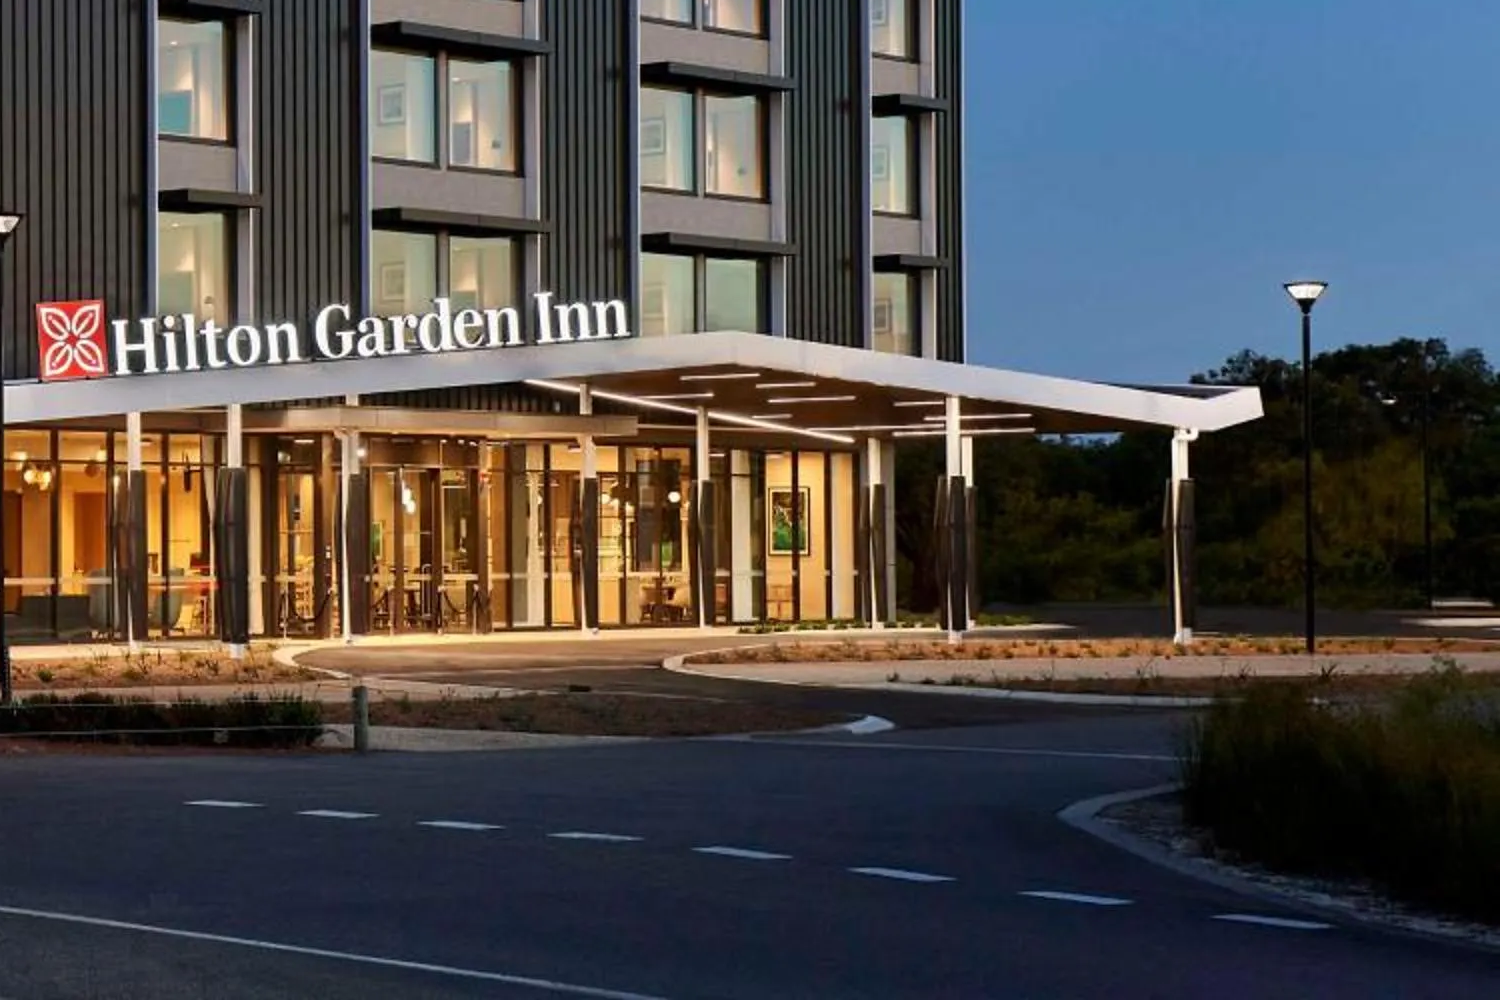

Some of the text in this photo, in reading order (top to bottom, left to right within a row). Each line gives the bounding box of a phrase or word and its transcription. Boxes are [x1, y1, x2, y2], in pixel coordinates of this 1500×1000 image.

[112, 291, 632, 375] Hilton Garden Inn
